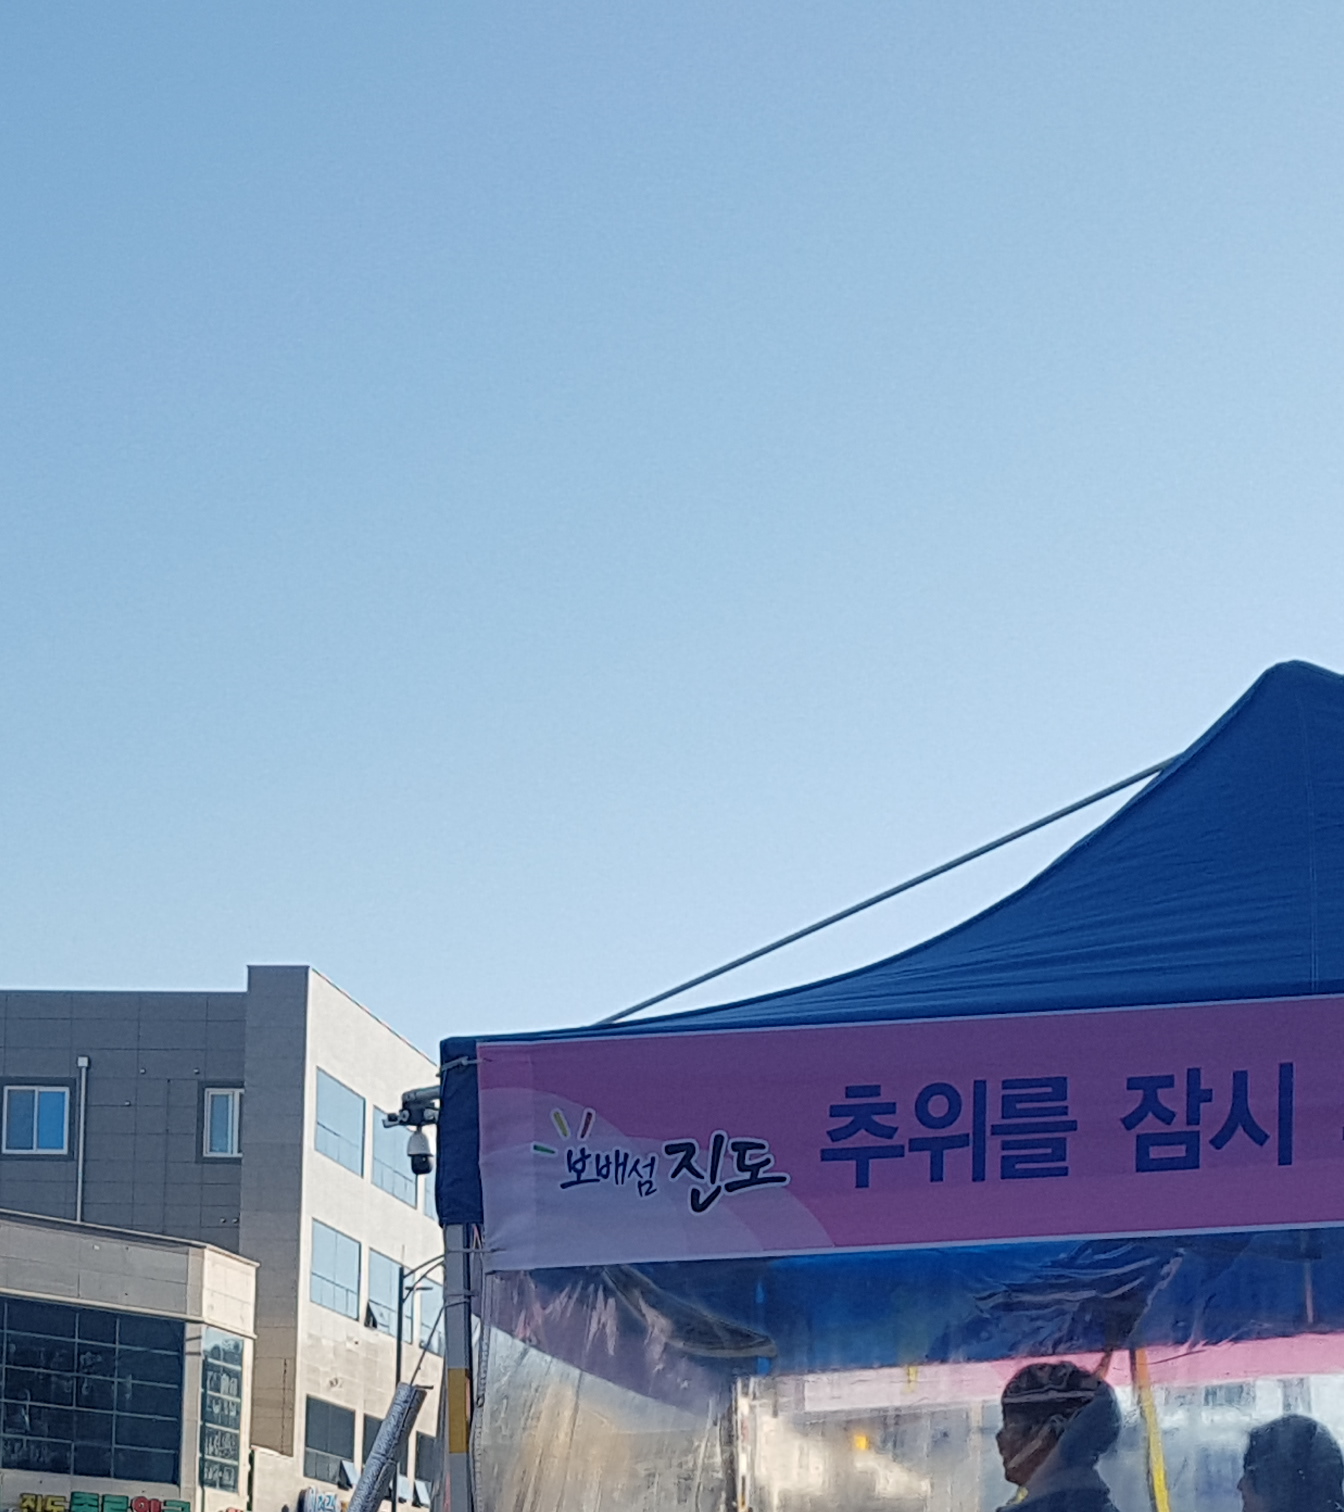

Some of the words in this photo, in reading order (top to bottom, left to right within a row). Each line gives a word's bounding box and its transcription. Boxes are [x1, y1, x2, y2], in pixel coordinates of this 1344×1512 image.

[559, 1147, 657, 1197] 보배섬
[664, 1132, 789, 1213] 진도
[820, 1076, 1078, 1189] 추위를
[1120, 1062, 1294, 1173] 잠시
